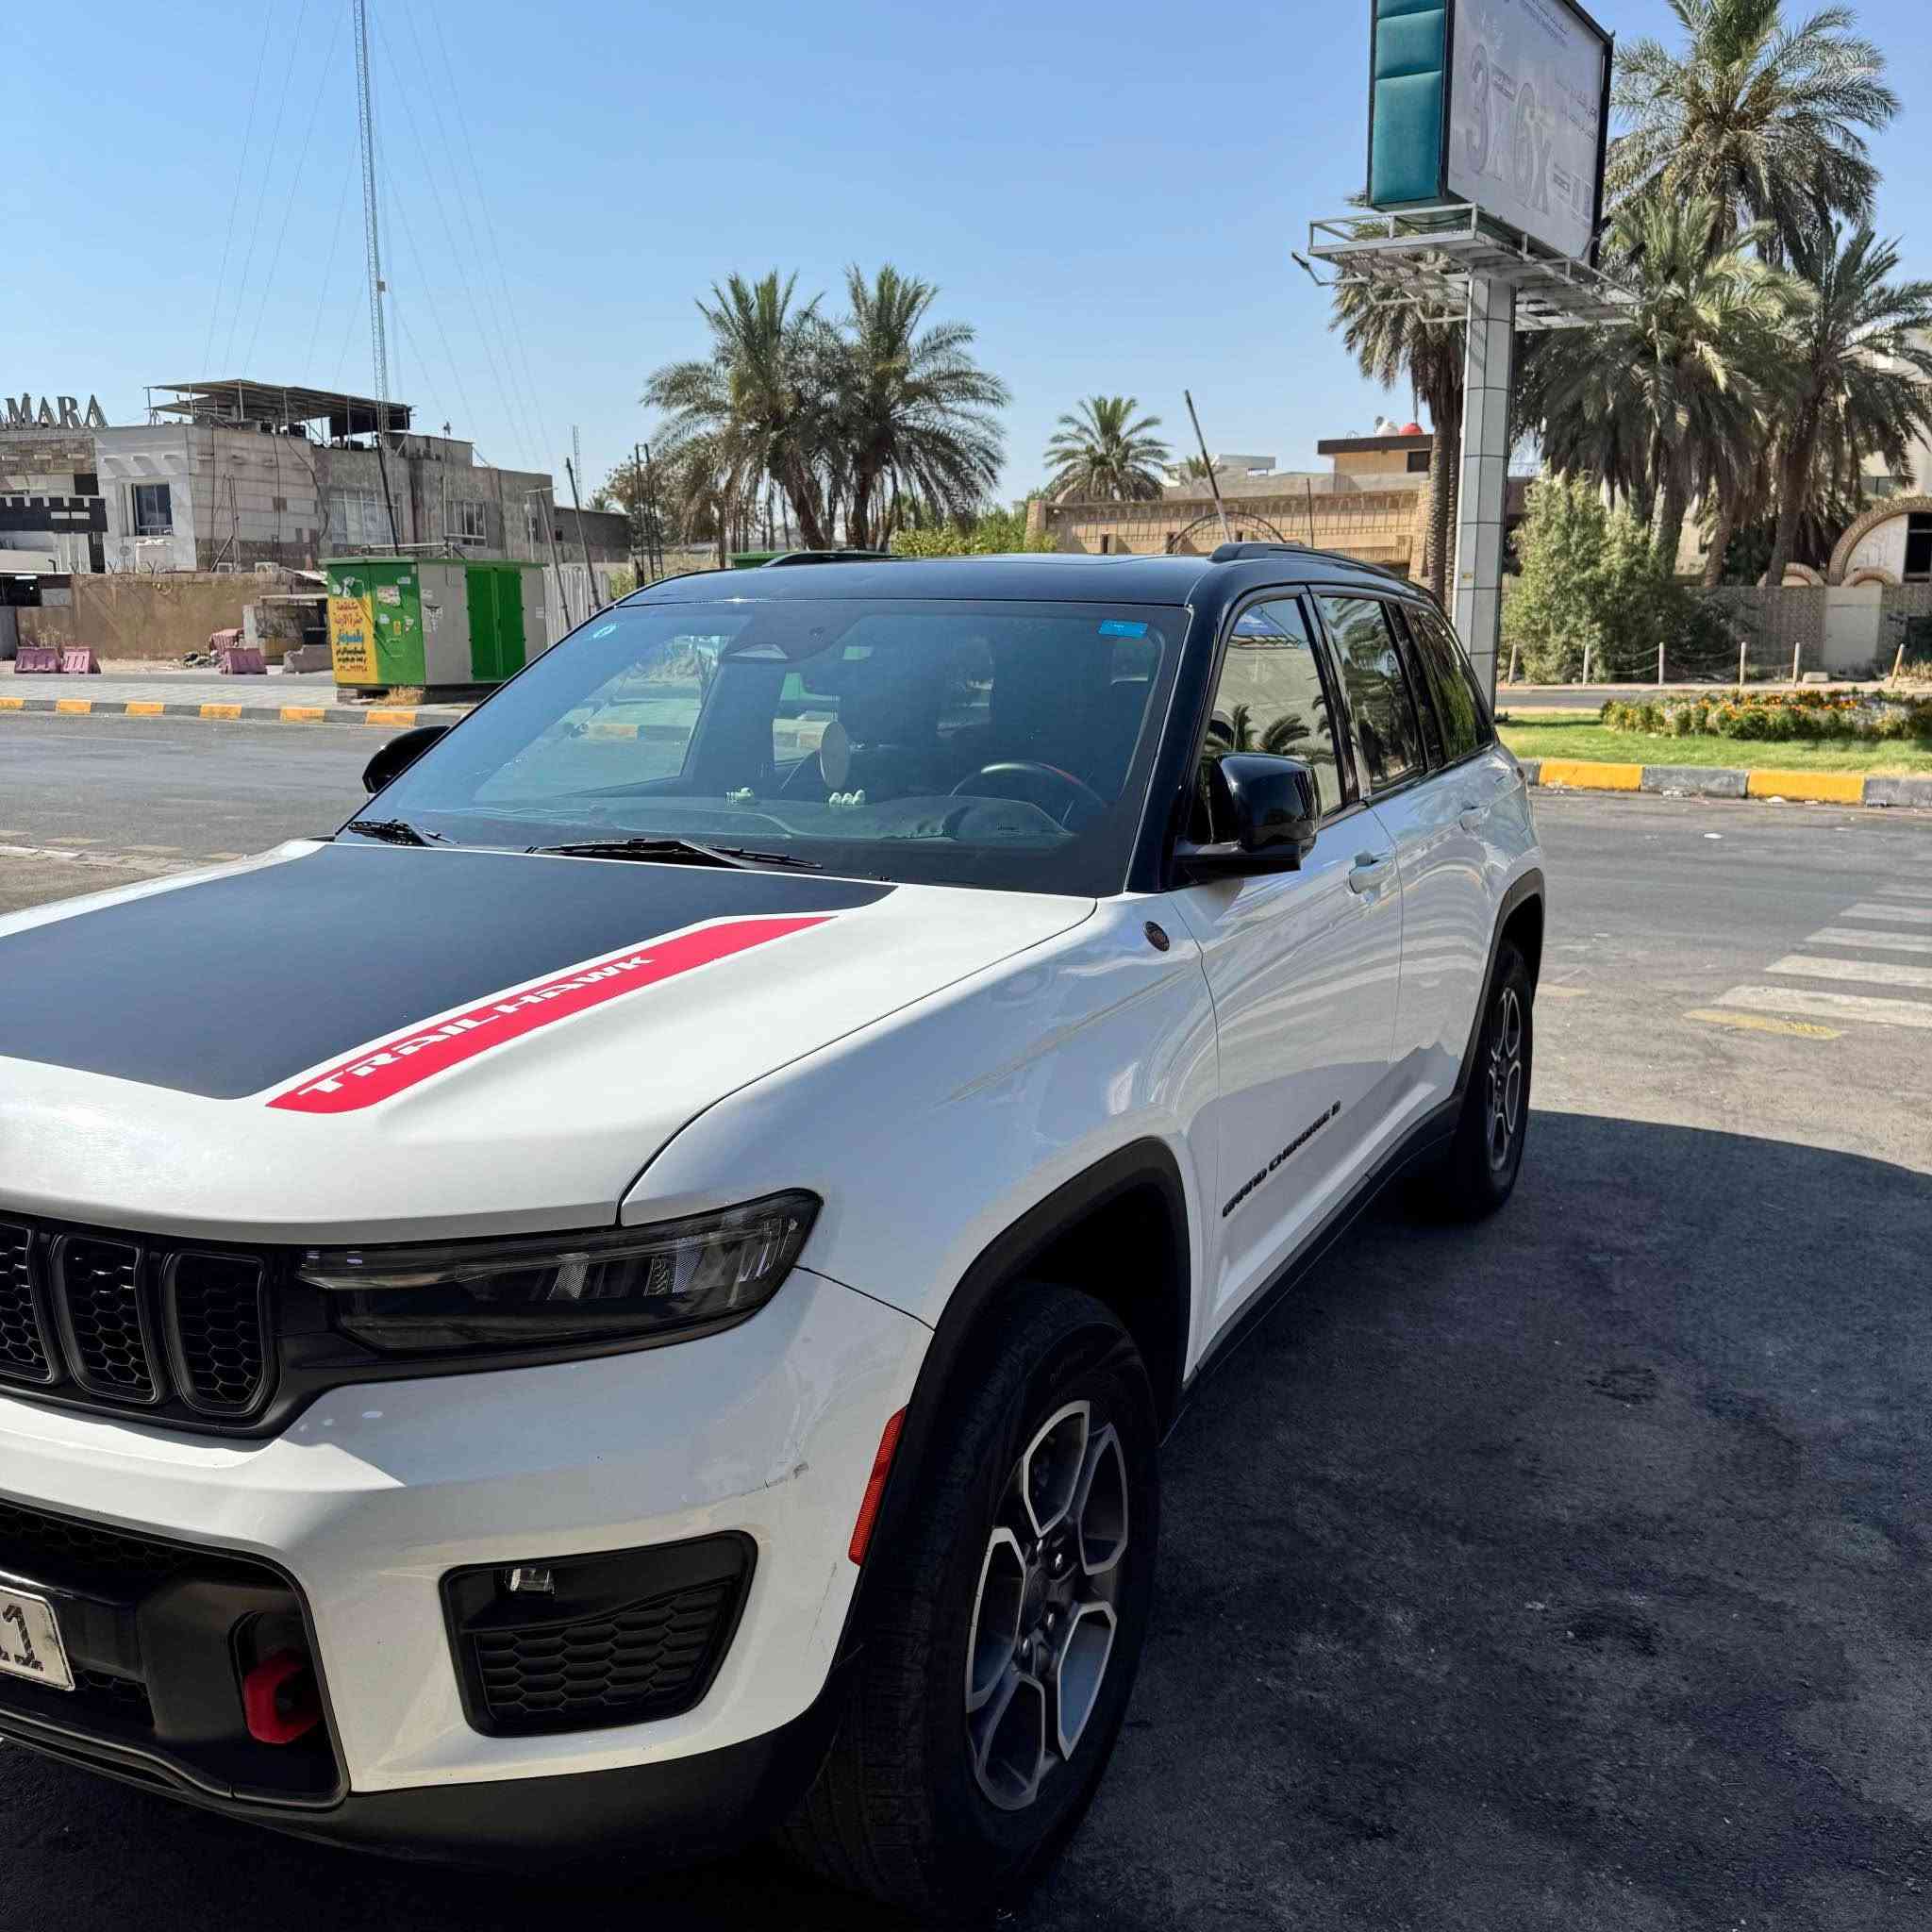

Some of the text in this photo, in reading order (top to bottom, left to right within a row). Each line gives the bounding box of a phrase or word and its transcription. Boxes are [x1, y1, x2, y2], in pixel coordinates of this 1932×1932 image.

[0, 393, 108, 430] MARA
[297, 956, 656, 1096] TRAILHAWK
[0, 1605, 43, 1671] 1
